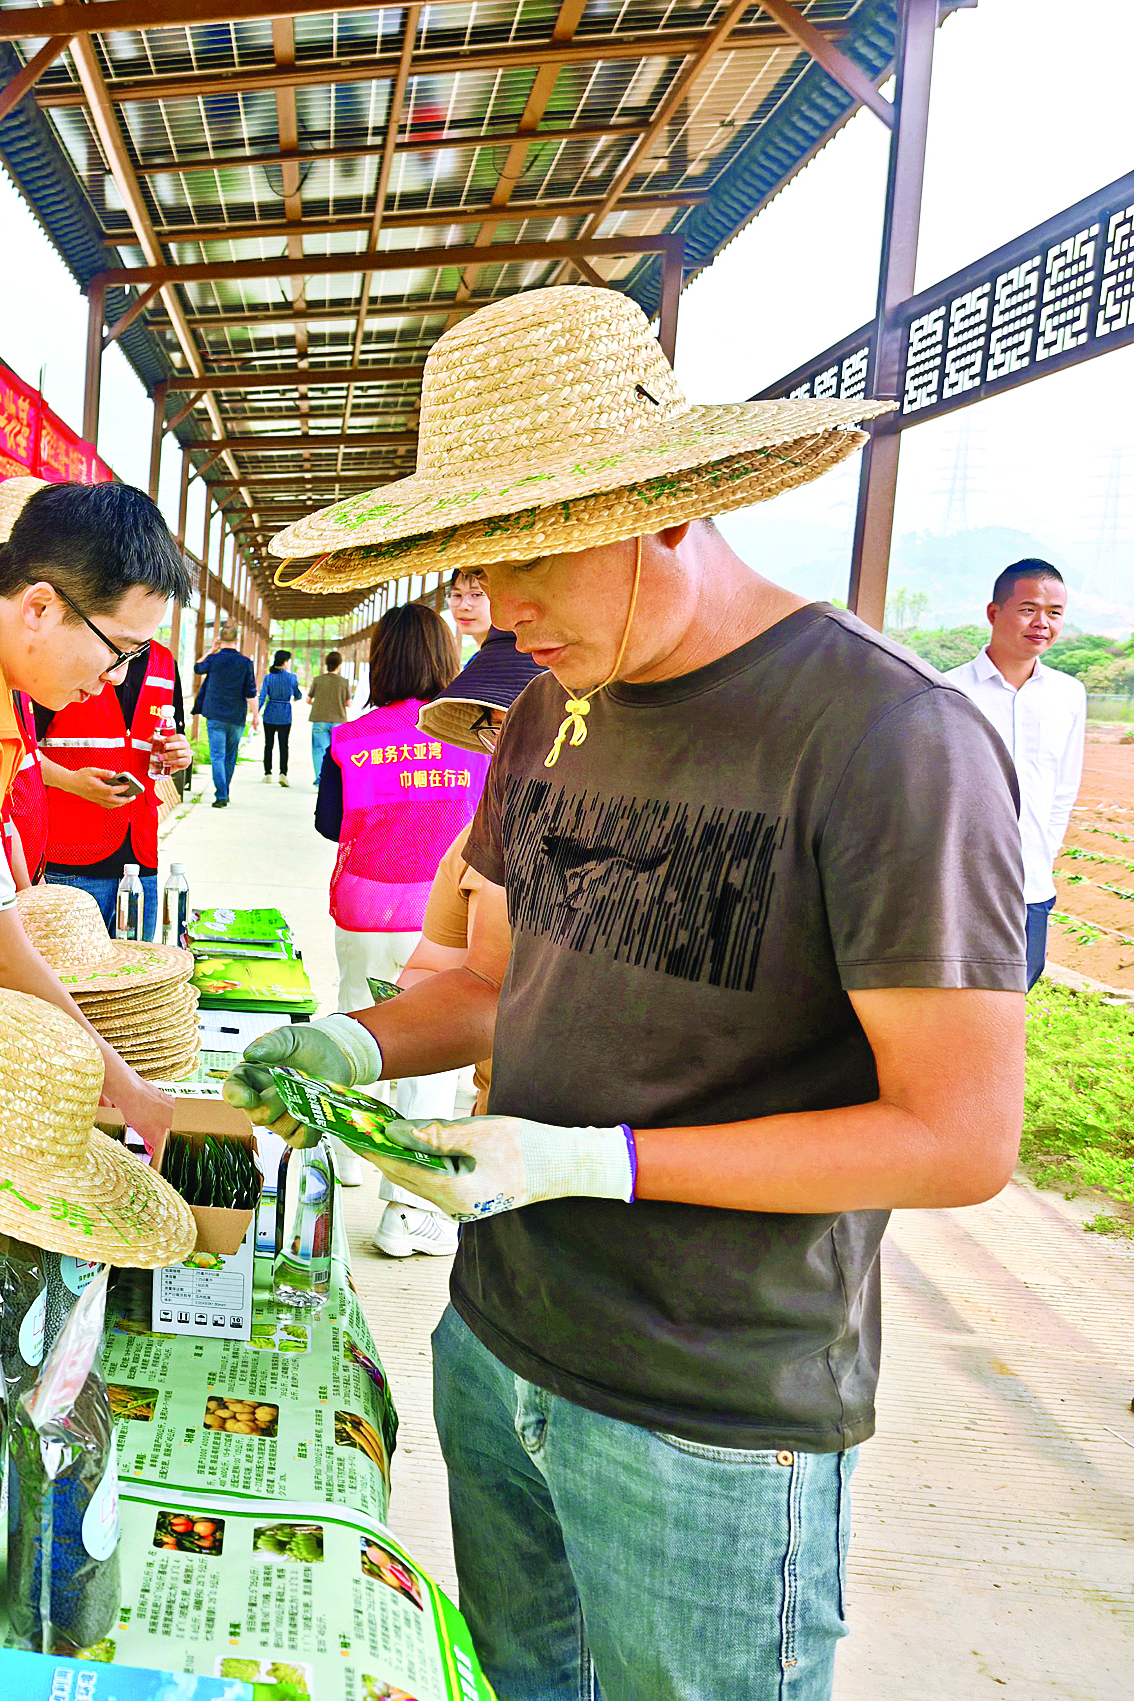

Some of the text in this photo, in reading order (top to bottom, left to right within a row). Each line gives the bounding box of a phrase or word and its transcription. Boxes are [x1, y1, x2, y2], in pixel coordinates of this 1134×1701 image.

[371, 742, 442, 765] 服务大亚湾
[399, 769, 470, 788] 巾帼在行动
[183, 1428, 196, 1443] 马铃薯
